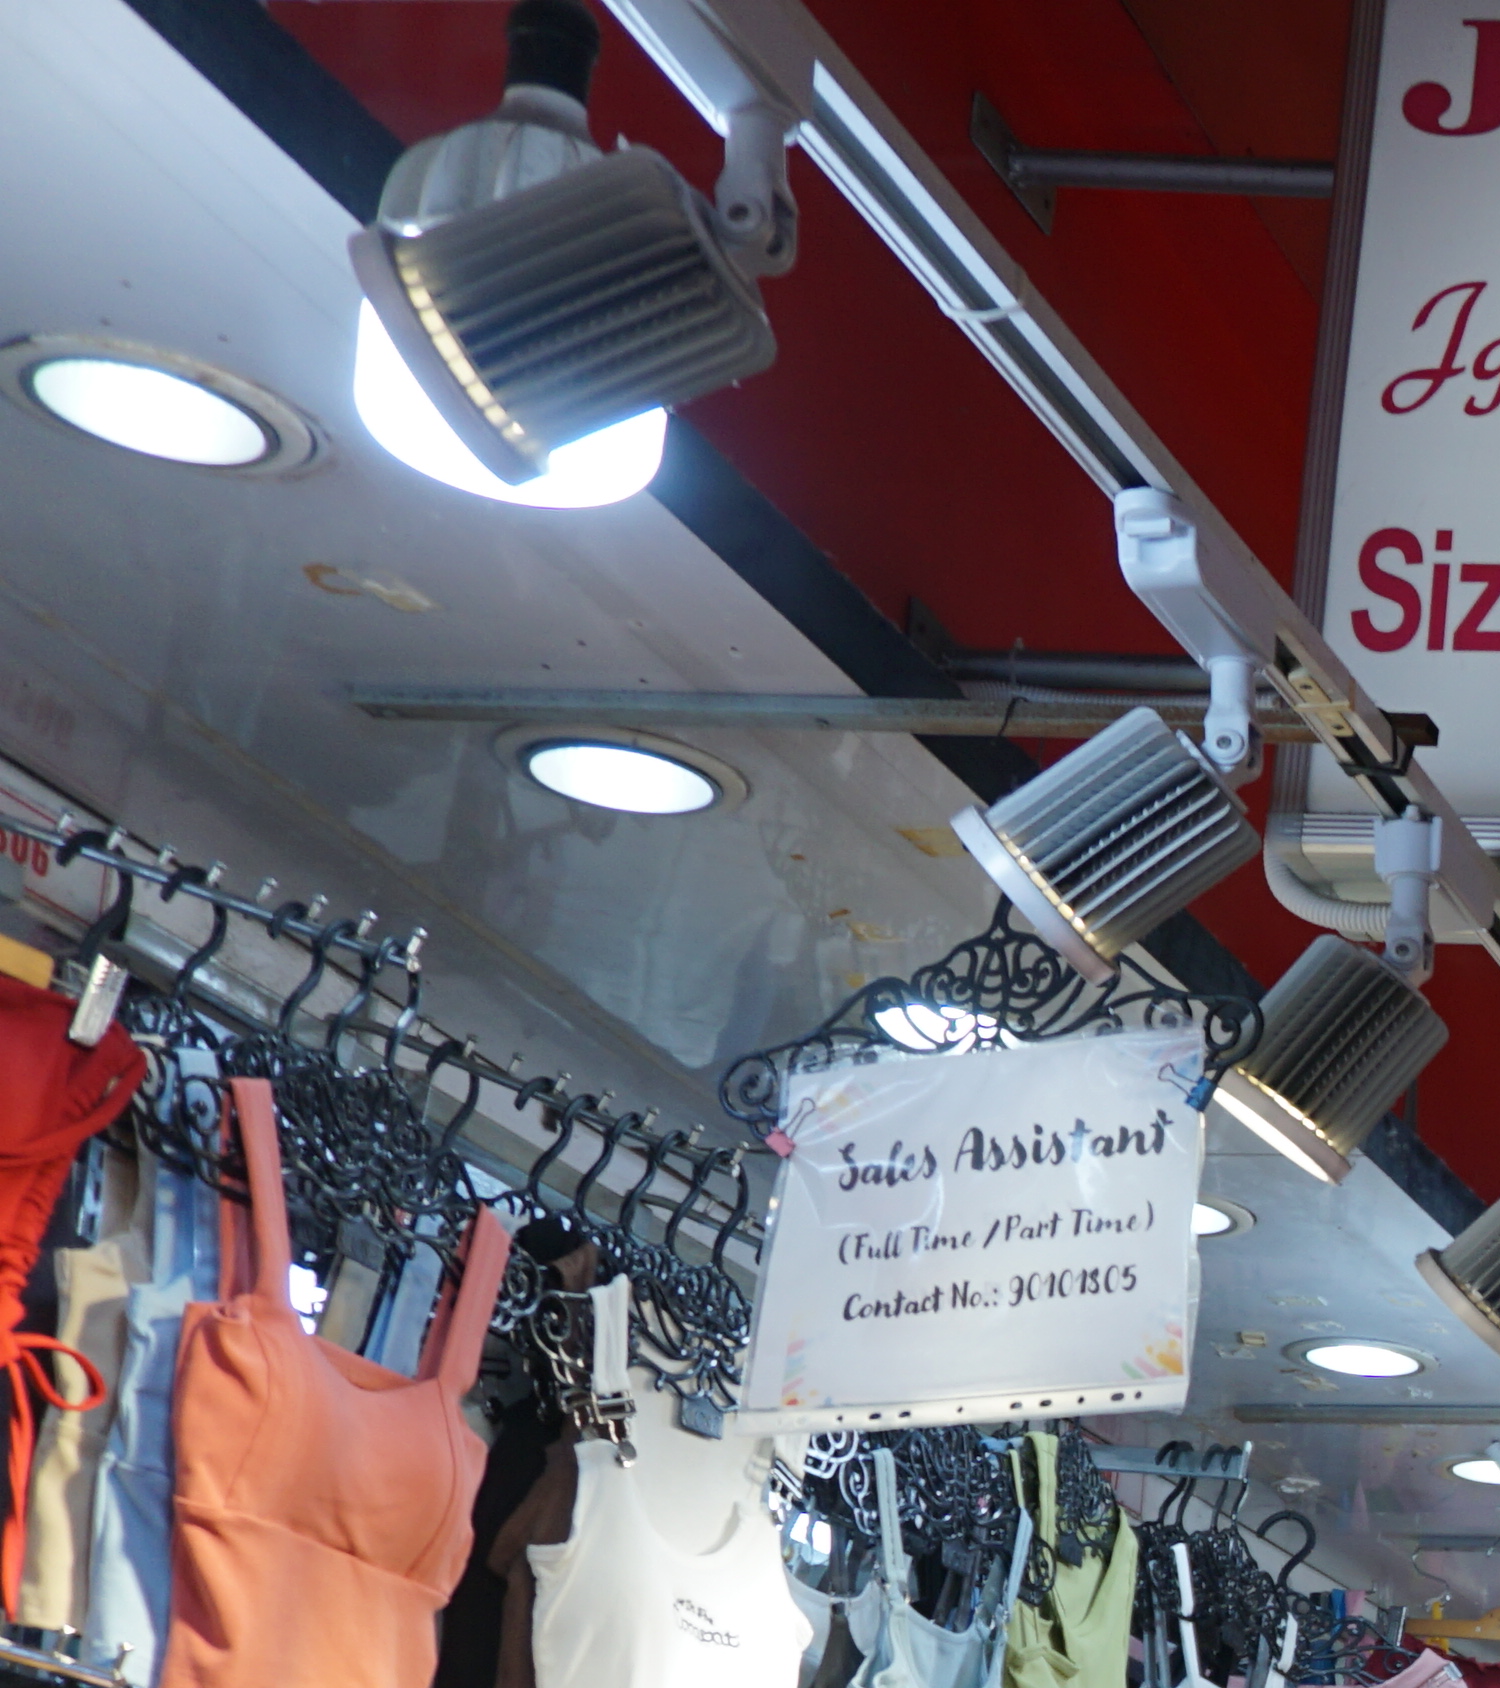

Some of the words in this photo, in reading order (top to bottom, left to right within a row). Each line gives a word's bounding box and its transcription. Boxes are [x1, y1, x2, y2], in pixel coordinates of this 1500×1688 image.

[838, 1140, 937, 1192] Sales
[954, 1109, 1174, 1173] Assistant
[837, 1230, 901, 1266] (Full
[911, 1225, 975, 1255] Time
[1071, 1200, 1154, 1236] Time)
[842, 1286, 944, 1321] Contact
[951, 1280, 999, 1311] No.:
